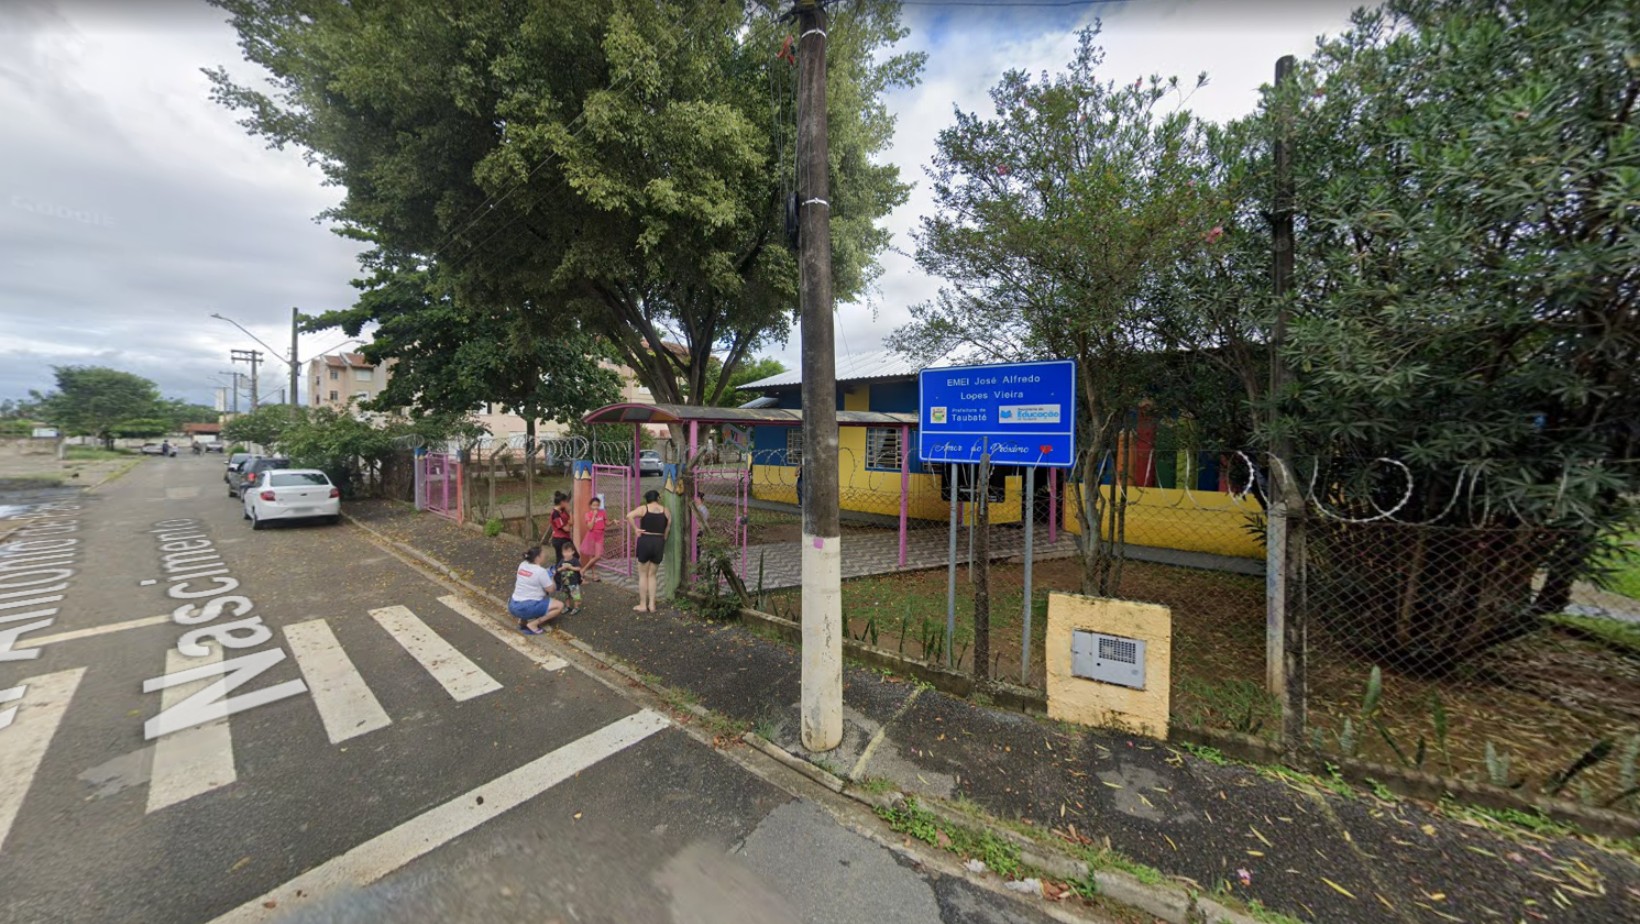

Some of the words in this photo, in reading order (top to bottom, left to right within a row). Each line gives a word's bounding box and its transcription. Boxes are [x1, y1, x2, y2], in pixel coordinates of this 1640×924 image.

[947, 378, 970, 386] EMEI
[974, 376, 997, 386] José
[1002, 373, 1041, 384] Alfredo
[960, 391, 988, 401] Lopes
[993, 390, 1024, 399] Vieira
[952, 413, 987, 422] Taubaté
[1017, 410, 1059, 419] Educação
